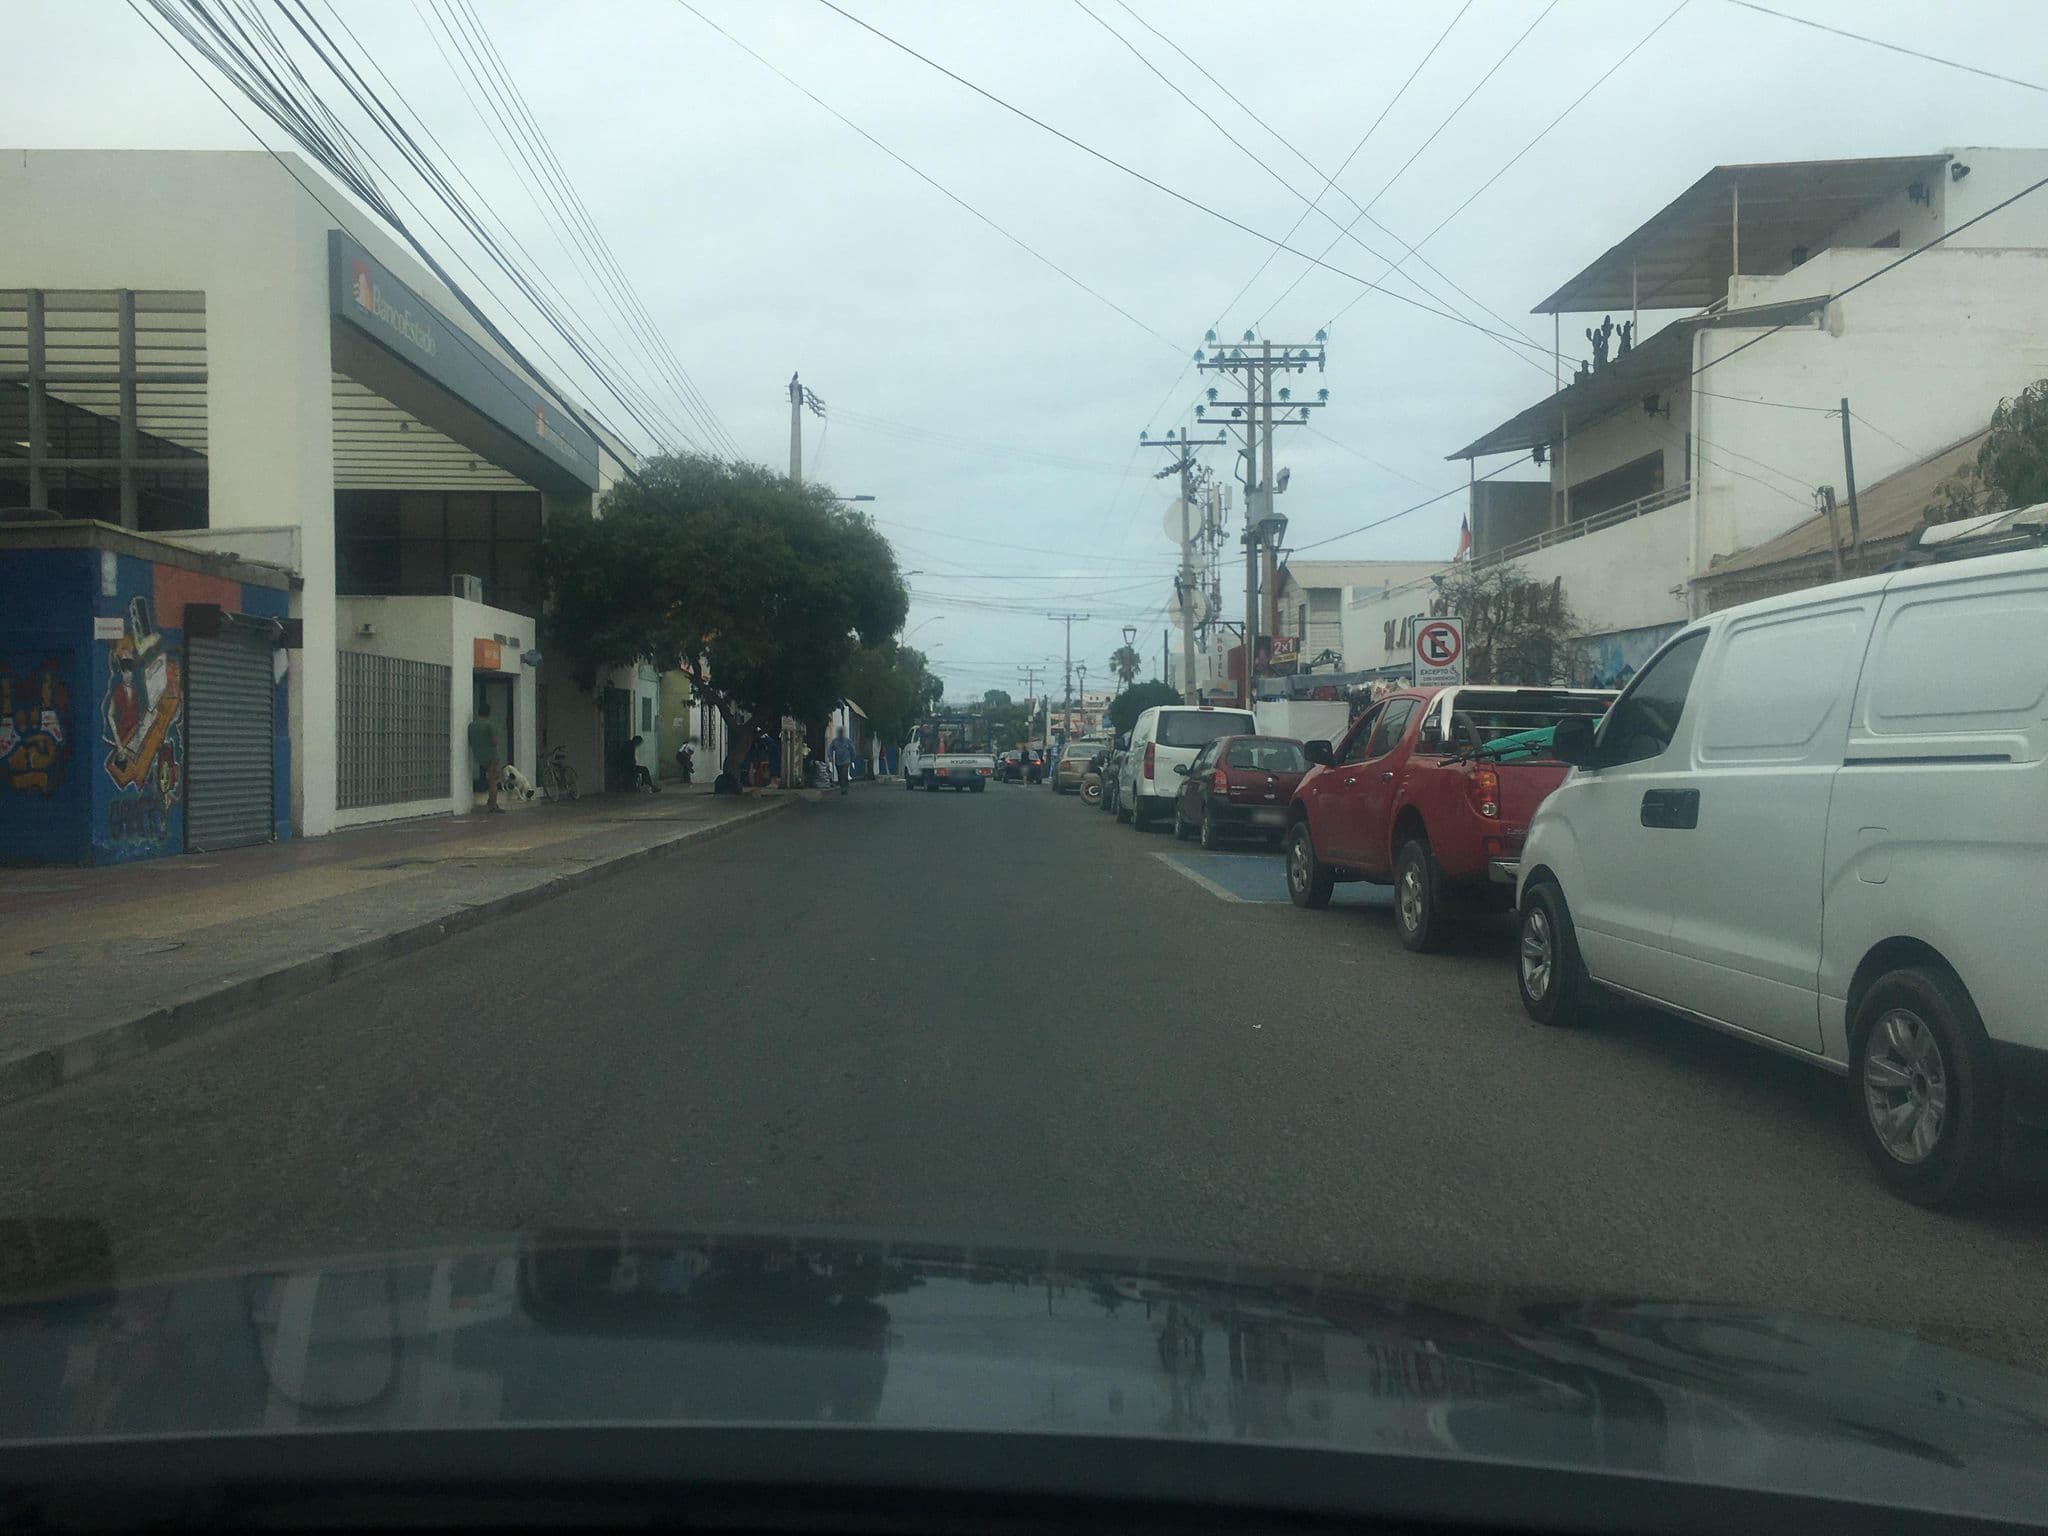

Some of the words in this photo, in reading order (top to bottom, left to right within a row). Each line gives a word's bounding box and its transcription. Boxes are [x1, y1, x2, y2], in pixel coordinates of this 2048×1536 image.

[1216, 637, 1224, 678] HOTEL
[1273, 638, 1294, 655] 2x1
[1431, 630, 1448, 658] E
